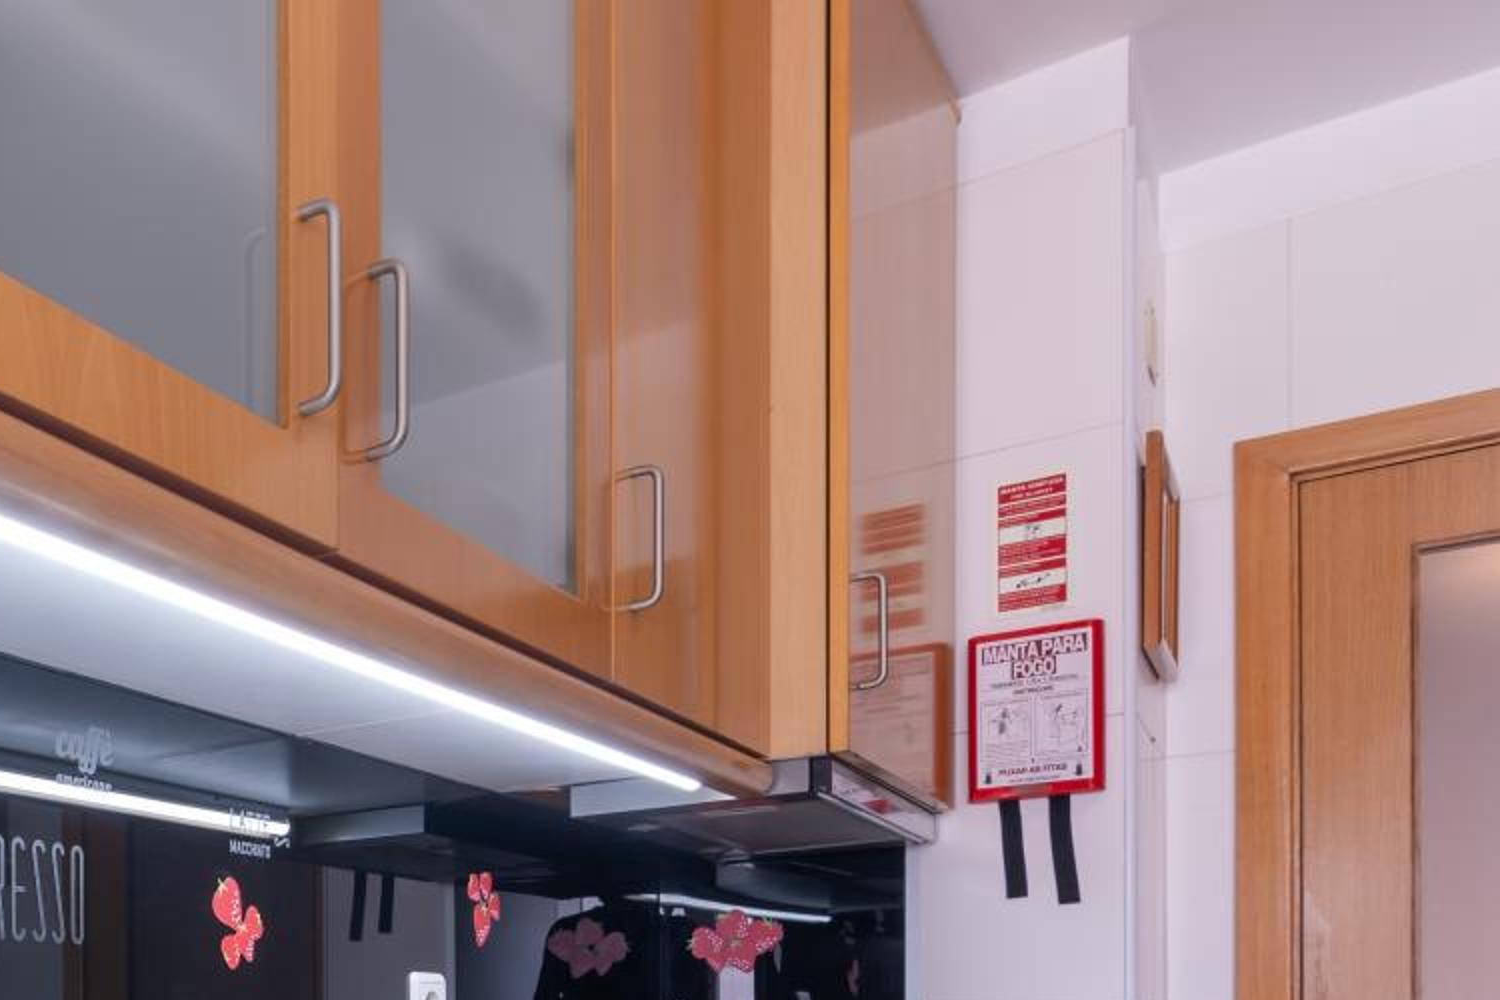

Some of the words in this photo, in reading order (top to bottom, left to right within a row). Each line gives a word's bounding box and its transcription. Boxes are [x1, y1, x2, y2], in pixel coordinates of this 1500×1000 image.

[982, 640, 1039, 665] MANTA
[1041, 633, 1087, 657] PARA
[1012, 655, 1056, 680] FOGO
